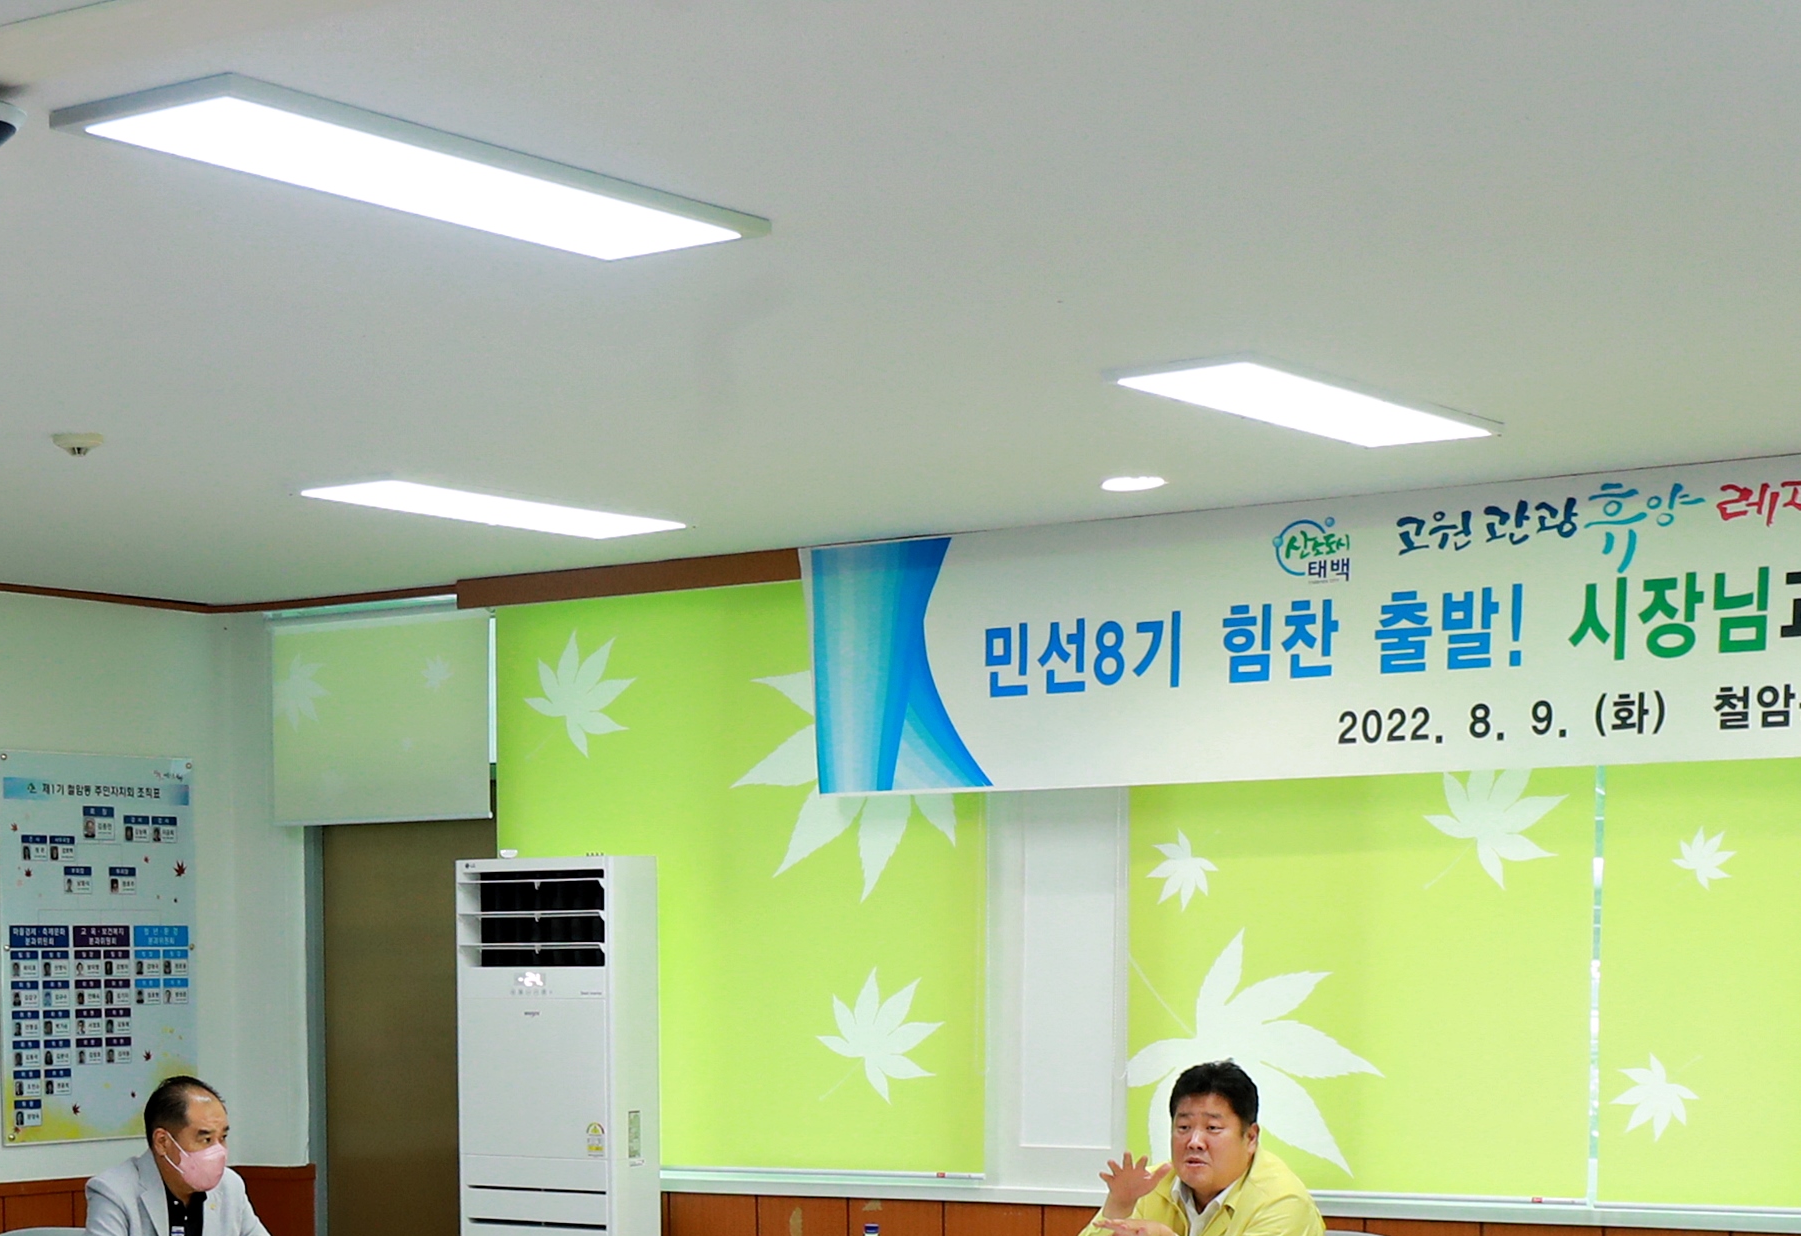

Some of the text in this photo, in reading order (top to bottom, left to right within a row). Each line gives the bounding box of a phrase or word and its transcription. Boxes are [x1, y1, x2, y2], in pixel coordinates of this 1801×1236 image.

[1396, 510, 1472, 556] 고원
[1483, 497, 1579, 547] 관광
[1584, 482, 1706, 574] 휴양
[1307, 557, 1350, 582] 태백
[984, 610, 1182, 698] 민선8기
[1221, 599, 1340, 684] 힘찬
[1374, 583, 1523, 674] 출발!
[1337, 683, 1801, 745] 2022. 8. 9. (화) 철암
[42, 783, 161, 799] 제1기 철암동 주민자치회 조직표
